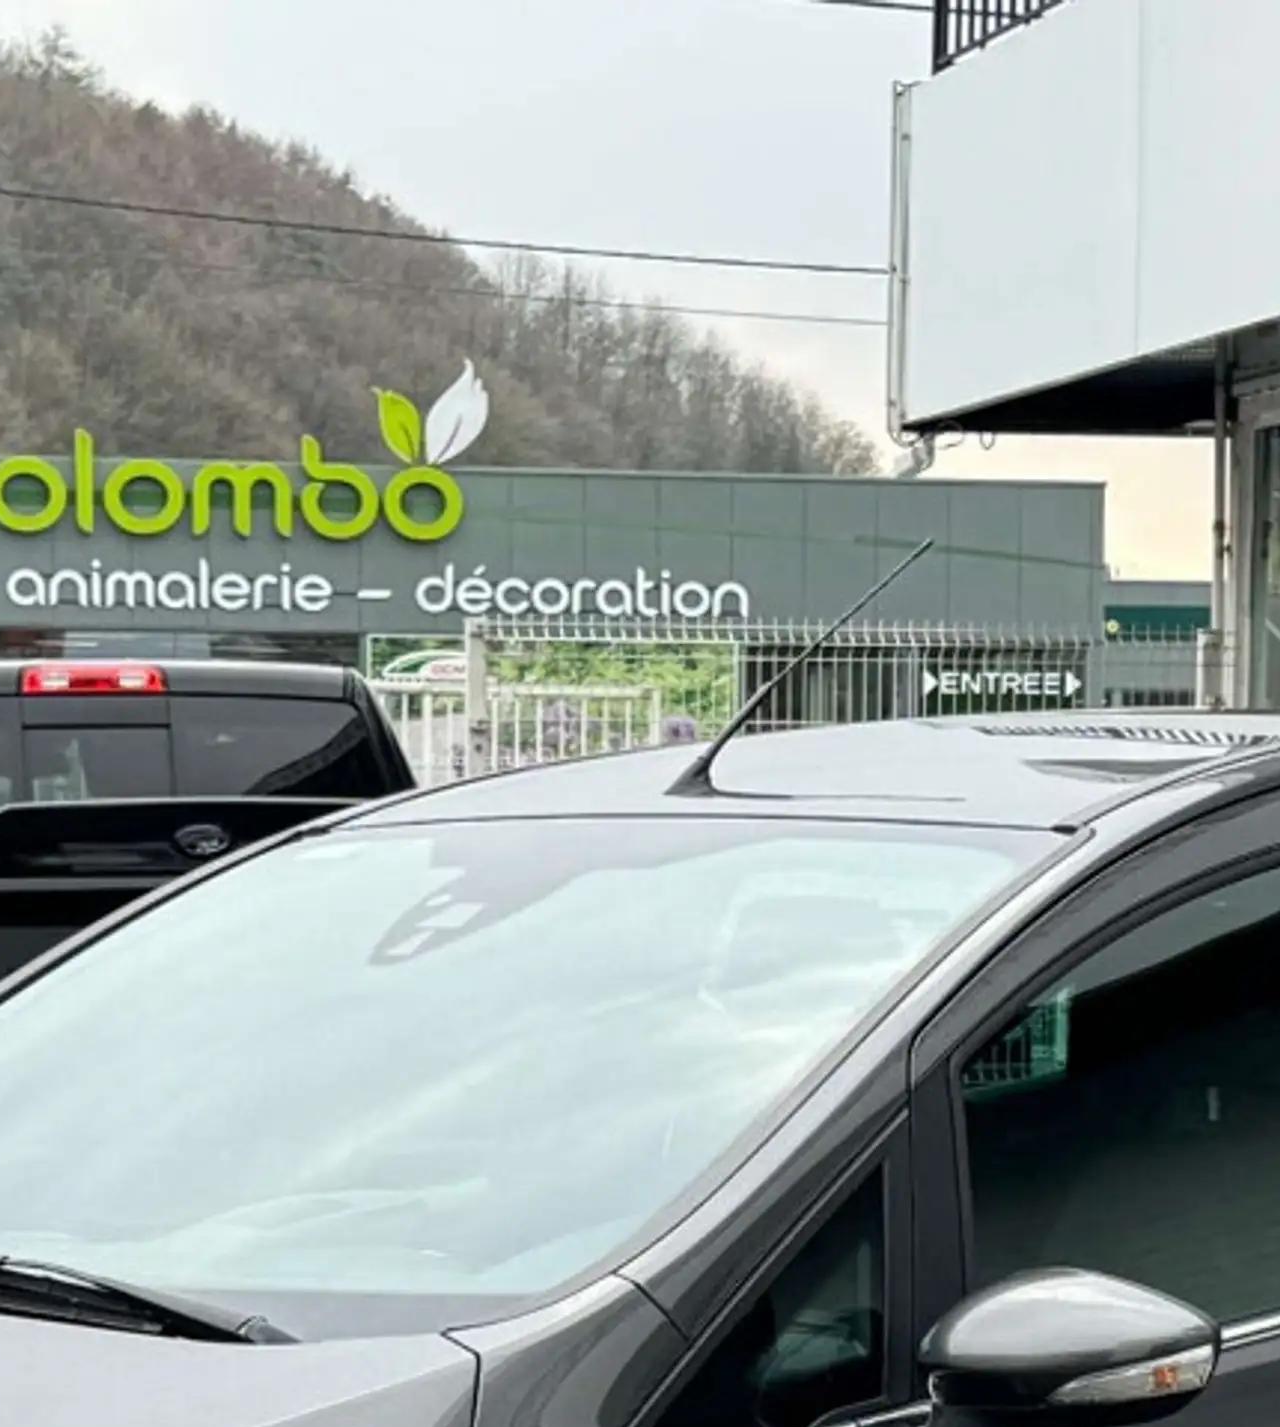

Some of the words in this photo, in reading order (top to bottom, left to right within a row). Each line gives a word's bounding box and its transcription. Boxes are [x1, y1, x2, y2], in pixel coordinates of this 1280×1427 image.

[6, 557, 334, 612] animalerie
[415, 562, 749, 619] décoration
[939, 671, 1061, 696] ENTREE
